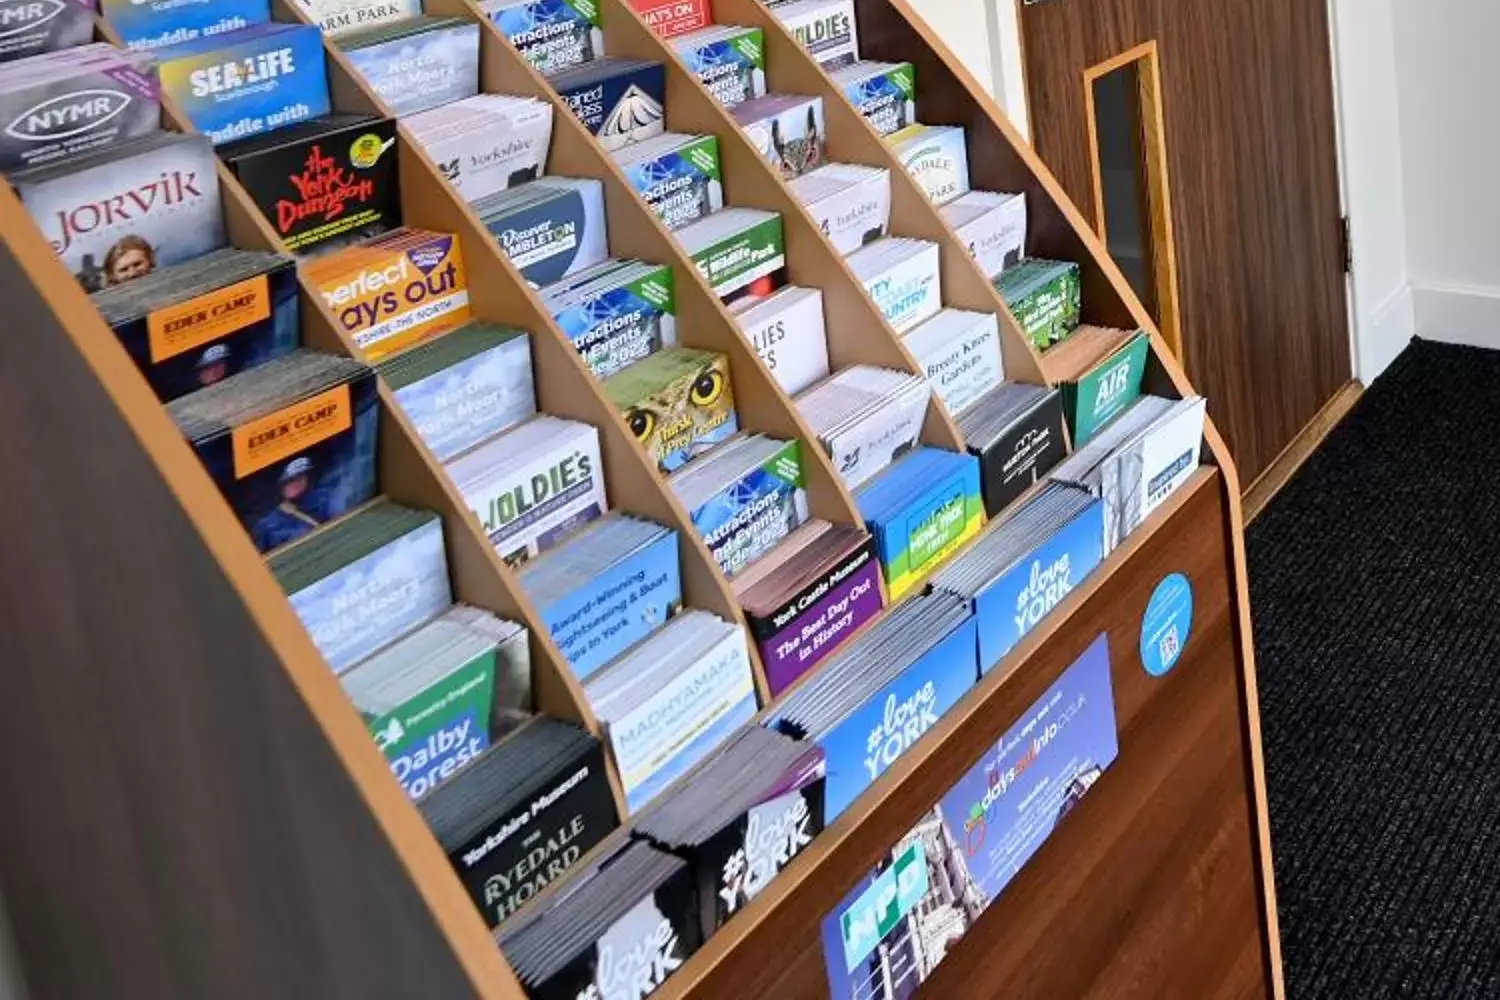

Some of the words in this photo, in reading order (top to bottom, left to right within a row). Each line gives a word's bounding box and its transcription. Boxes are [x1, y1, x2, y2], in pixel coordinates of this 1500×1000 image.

[203, 16, 247, 37] with
[315, 13, 351, 36] ARM
[356, 2, 400, 23] PARK
[27, 97, 112, 134] NYMR
[206, 115, 263, 145] addle
[267, 102, 310, 126] with
[277, 174, 373, 233] Dungeon
[505, 222, 577, 256] AMBLETON
[163, 311, 207, 335] EDEN
[211, 292, 257, 317] CAMP
[339, 289, 399, 332] ays
[404, 263, 458, 304] out
[248, 423, 290, 450] EDEN
[294, 403, 338, 430] CAMP
[773, 607, 798, 628] York
[830, 550, 870, 587] Museum
[776, 638, 800, 660] The
[801, 614, 828, 640] Best
[827, 598, 850, 625] Day
[850, 578, 872, 599] Out
[1014, 571, 1075, 636] YORK
[813, 609, 856, 649] History
[391, 716, 472, 783] Dalby
[864, 703, 939, 780] YORK
[867, 681, 936, 754] #love
[401, 736, 483, 800] orest
[462, 809, 530, 868] Yorkshire
[530, 765, 589, 818] Museum
[483, 813, 586, 905] RYEDALE
[496, 844, 581, 922] HOARD
[719, 823, 813, 914] YORK
